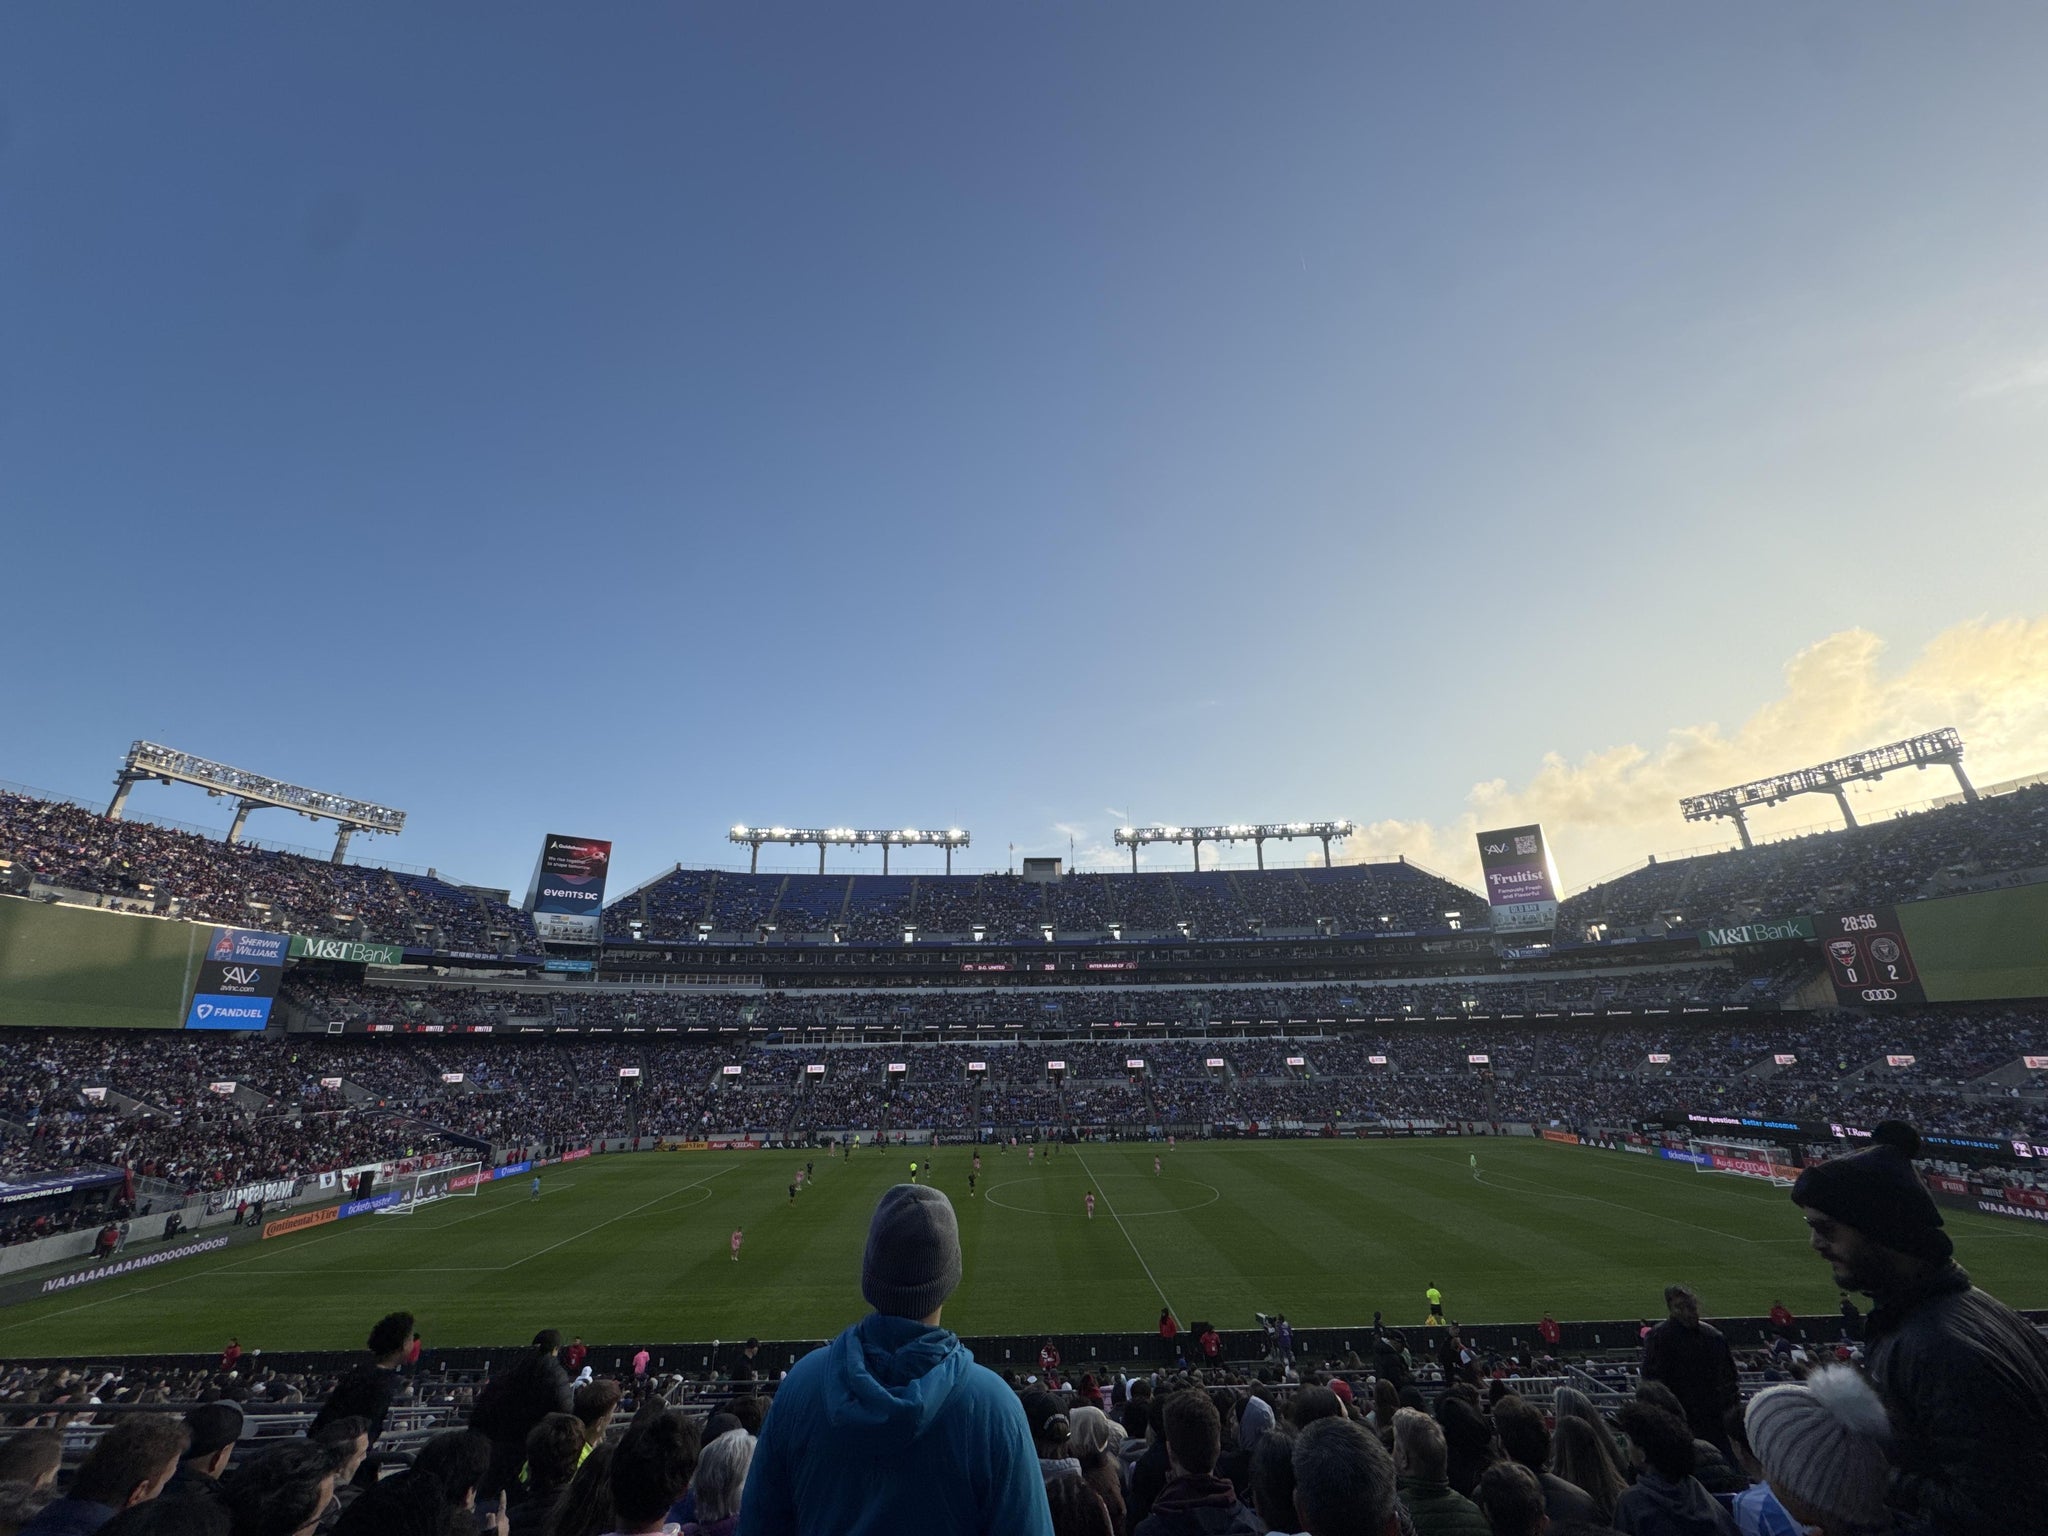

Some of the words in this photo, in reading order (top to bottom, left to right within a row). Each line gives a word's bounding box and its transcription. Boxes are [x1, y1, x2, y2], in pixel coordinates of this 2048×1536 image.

[1490, 870, 1544, 886] Fruitist
[1841, 913, 1878, 931] 28:56
[1706, 925, 1752, 946] M&T
[1752, 920, 1804, 941] Bank
[239, 936, 281, 949] SHERWIN
[302, 938, 352, 960] M&T
[351, 944, 393, 964] Bank
[1847, 968, 1858, 983] 0
[1887, 964, 1899, 980] 2
[219, 984, 255, 992] avinc.com
[214, 1007, 263, 1018] FANDUEL
[1742, 1119, 1762, 1127] Better
[1764, 1121, 1801, 1130] outcomes.
[1668, 1151, 1705, 1164] ticketmaster
[1717, 1159, 1733, 1168] Audi
[453, 1178, 467, 1187] Audi
[3, 1189, 53, 1203] TOUCHDOWN
[53, 1185, 73, 1195] CLUB
[264, 1180, 296, 1202] BRAVA
[348, 1195, 393, 1215] ticketmaster
[266, 1215, 314, 1236] Continental
